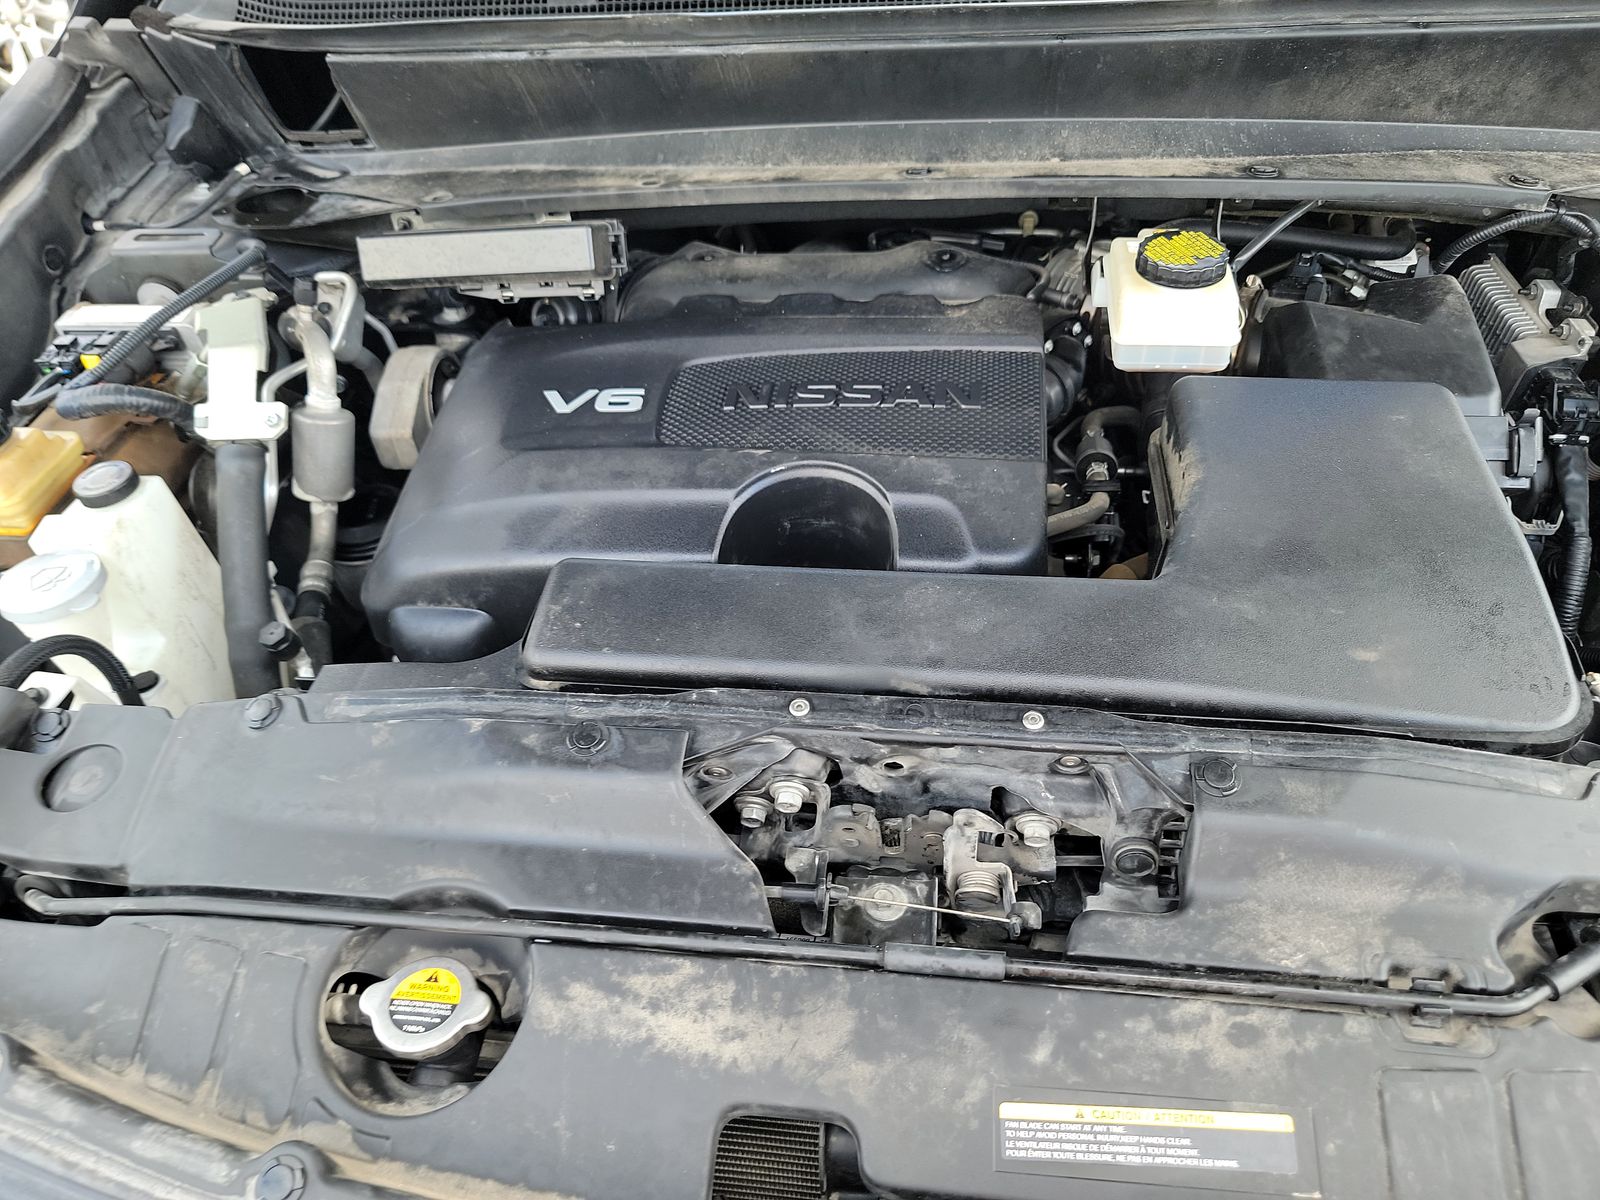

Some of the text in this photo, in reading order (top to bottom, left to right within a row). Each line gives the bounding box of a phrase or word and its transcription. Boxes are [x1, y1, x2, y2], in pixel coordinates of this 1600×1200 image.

[543, 387, 646, 414] V6
[722, 381, 982, 411] NISSAN
[1091, 1109, 1141, 1121] CAUTION
[1153, 1112, 1216, 1124] ATTENTION
[1020, 1122, 1043, 1130] BLADE
[1061, 1123, 1083, 1131] START
[1093, 1124, 1109, 1132] ANY
[1016, 1130, 1035, 1138] HELP
[1058, 1132, 1096, 1141] PERSONAL
[1005, 1140, 1015, 1148] LE
[1006, 1149, 1027, 1157] POUR
[1052, 1151, 1076, 1159] TOUTE
